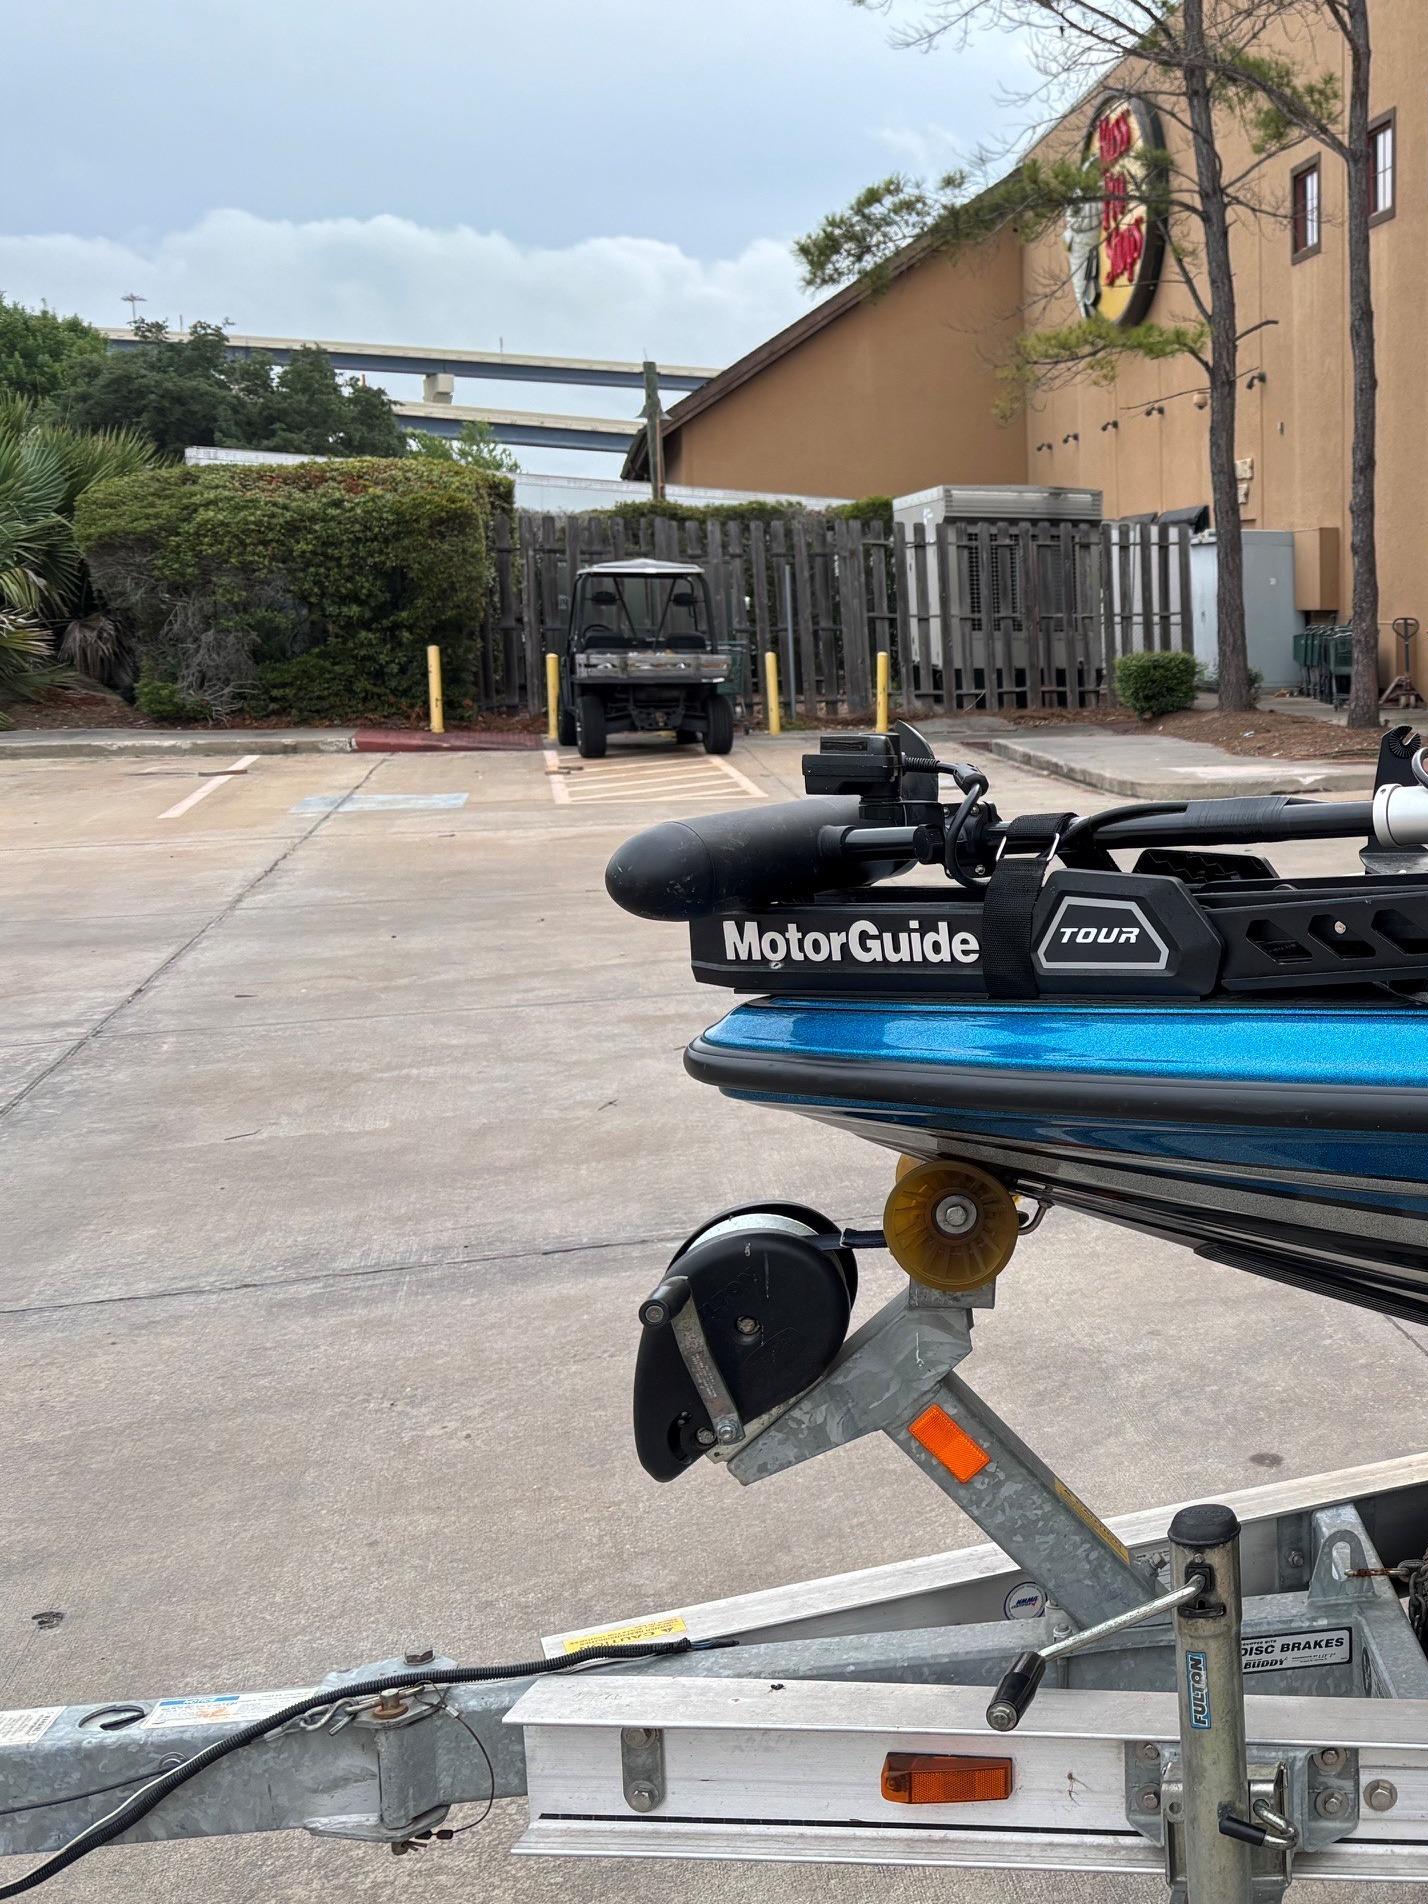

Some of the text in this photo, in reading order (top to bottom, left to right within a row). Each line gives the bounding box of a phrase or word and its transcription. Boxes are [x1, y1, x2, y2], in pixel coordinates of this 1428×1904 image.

[722, 919, 980, 963] MotorGuide
[1060, 926, 1140, 944] TOUR
[1241, 1637, 1345, 1656] DISC BRAKES
[1189, 1655, 1208, 1726] FULTON
